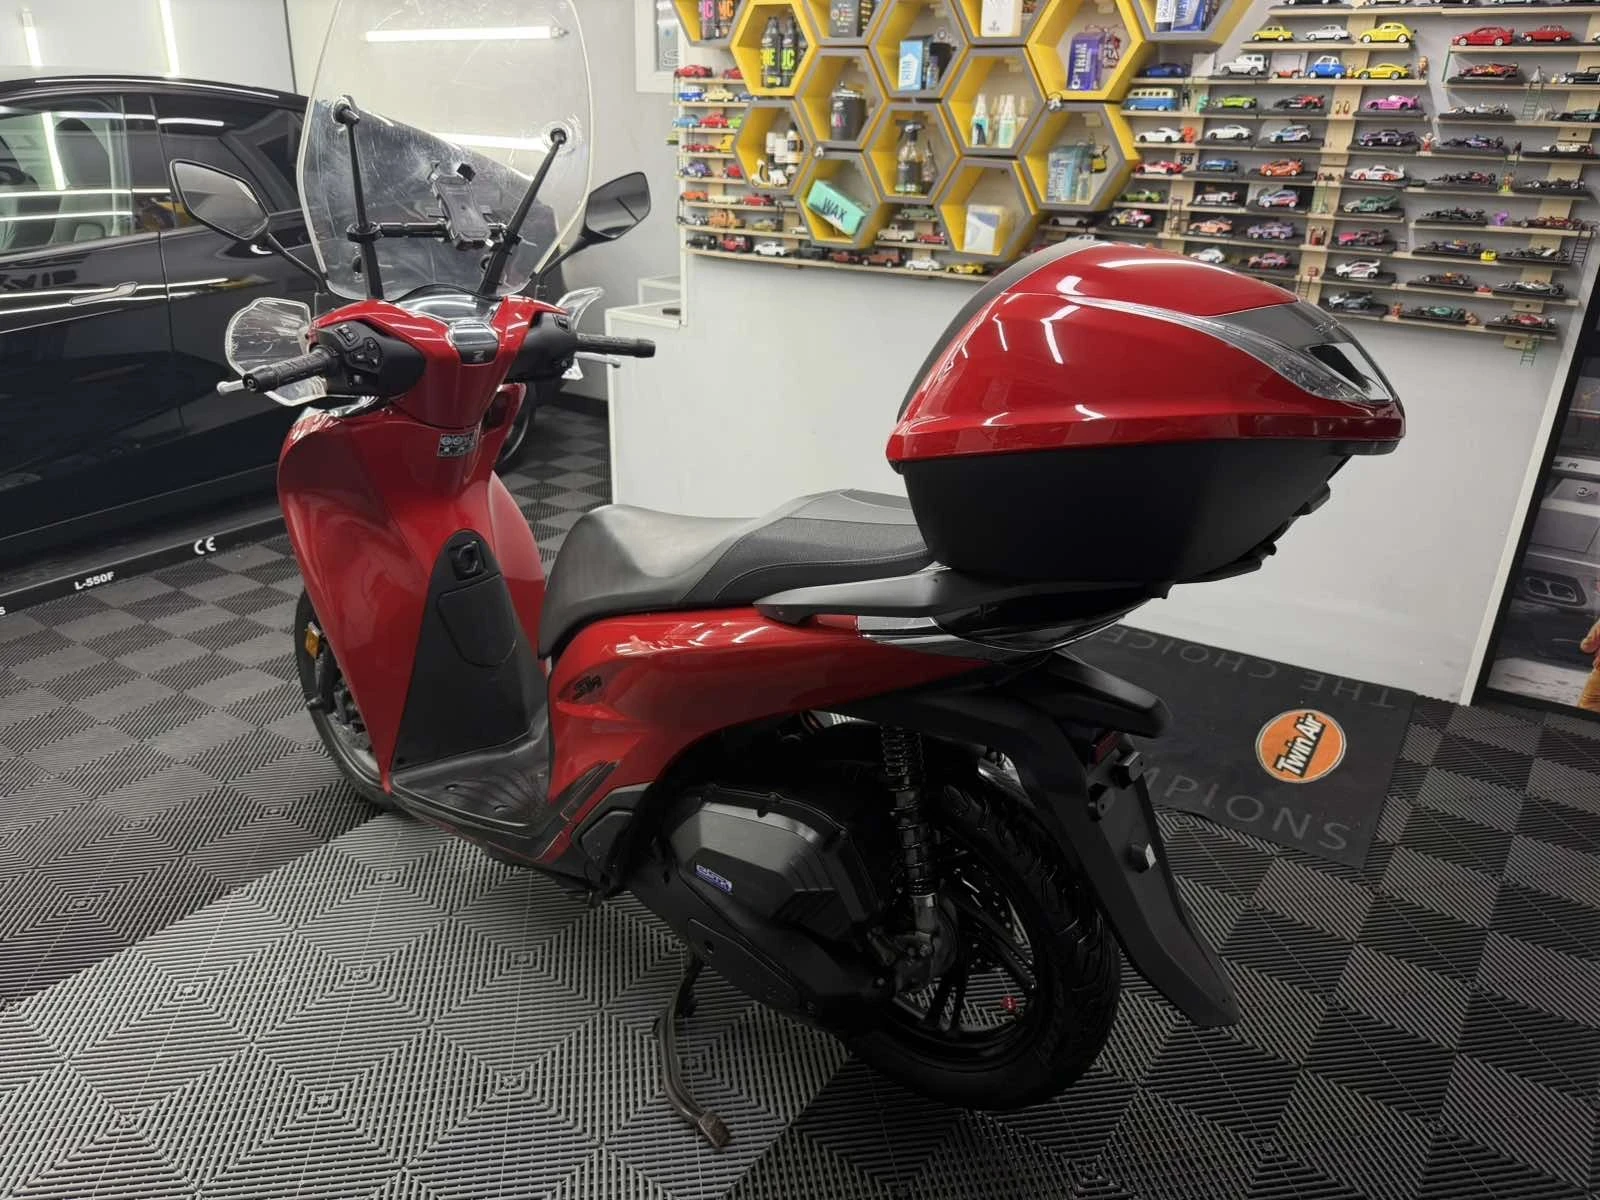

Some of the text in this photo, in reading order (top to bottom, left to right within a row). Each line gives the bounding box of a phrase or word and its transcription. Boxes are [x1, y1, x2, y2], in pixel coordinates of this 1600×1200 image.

[822, 196, 848, 224] WAX
[74, 571, 115, 590] L-550F
[1100, 627, 1396, 709] THE CHOICE
